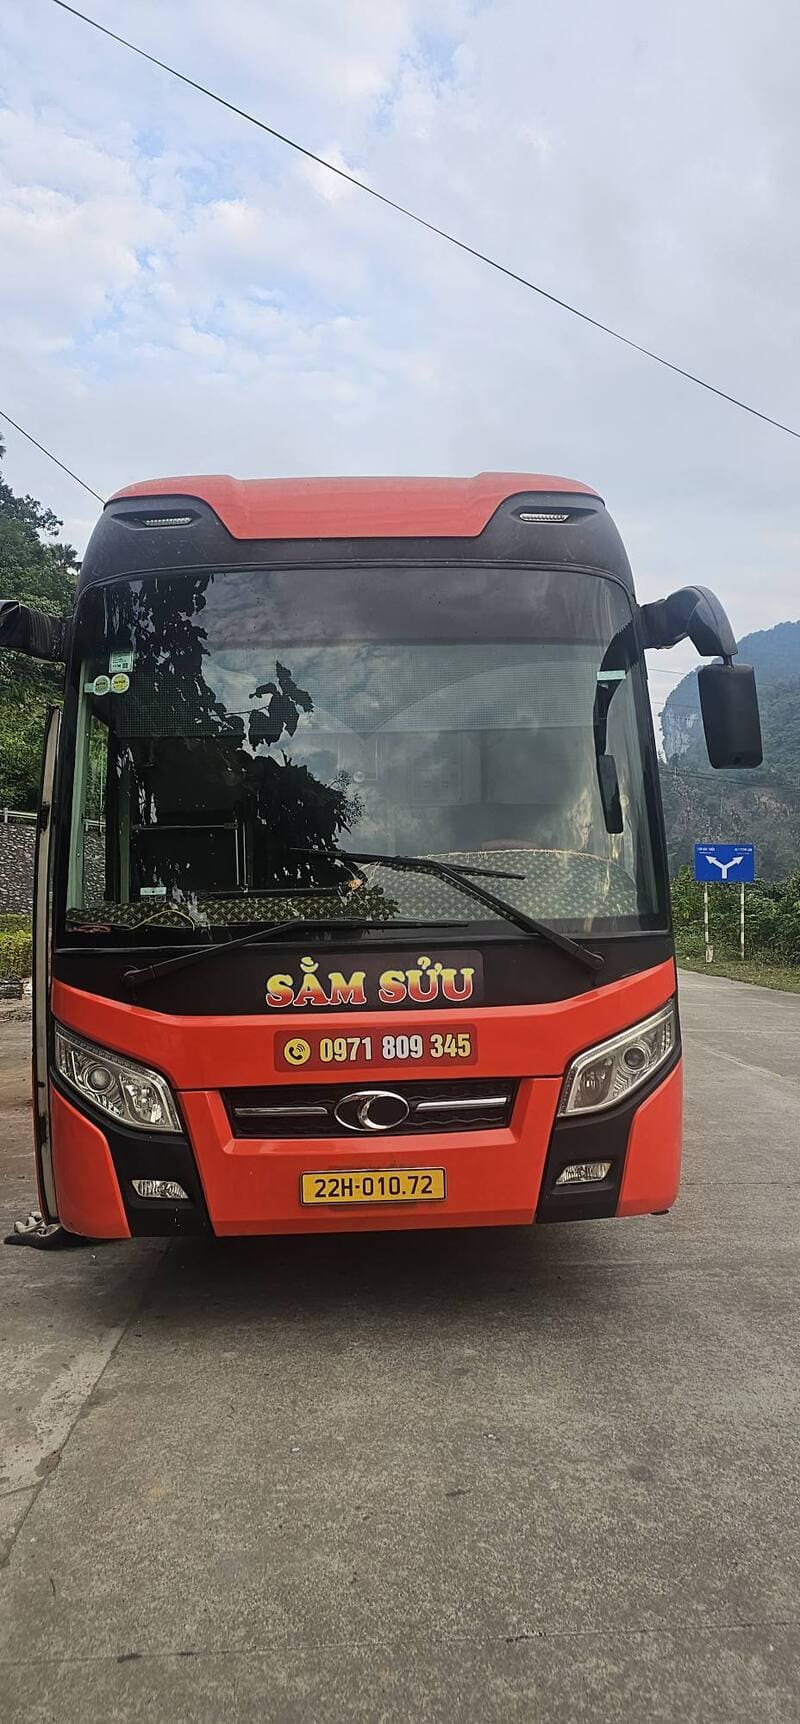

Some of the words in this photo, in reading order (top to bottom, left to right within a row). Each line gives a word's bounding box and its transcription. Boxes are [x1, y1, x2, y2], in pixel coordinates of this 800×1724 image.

[265, 956, 367, 1007] SẰM
[378, 955, 475, 1003] SỬU
[319, 1036, 373, 1062] 0971
[382, 1034, 423, 1060] 809
[430, 1033, 471, 1058] 345
[314, 1175, 433, 1198] 22H-010.72
